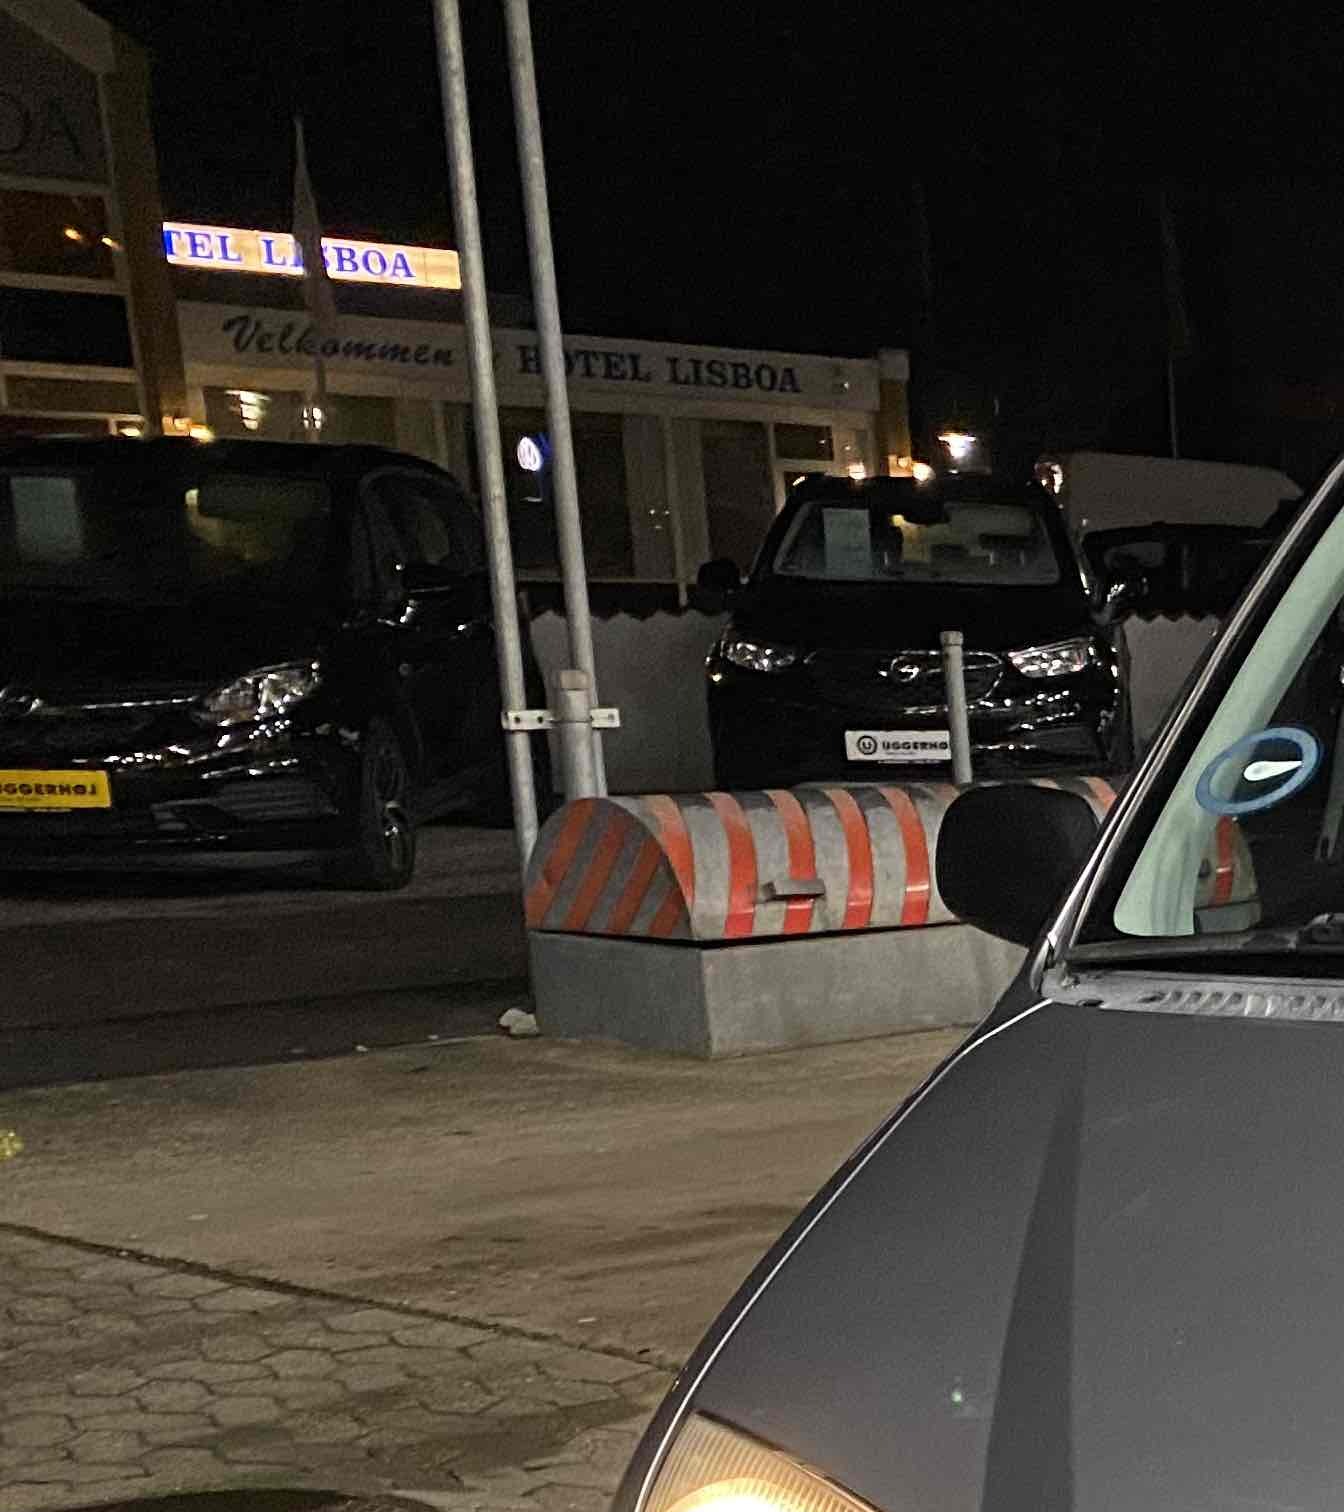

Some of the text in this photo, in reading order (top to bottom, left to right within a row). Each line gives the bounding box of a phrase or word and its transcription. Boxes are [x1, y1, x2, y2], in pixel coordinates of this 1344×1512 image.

[163, 230, 243, 262] TEL
[222, 315, 454, 366] Velkommen
[517, 345, 802, 393] HTEL LISBOA
